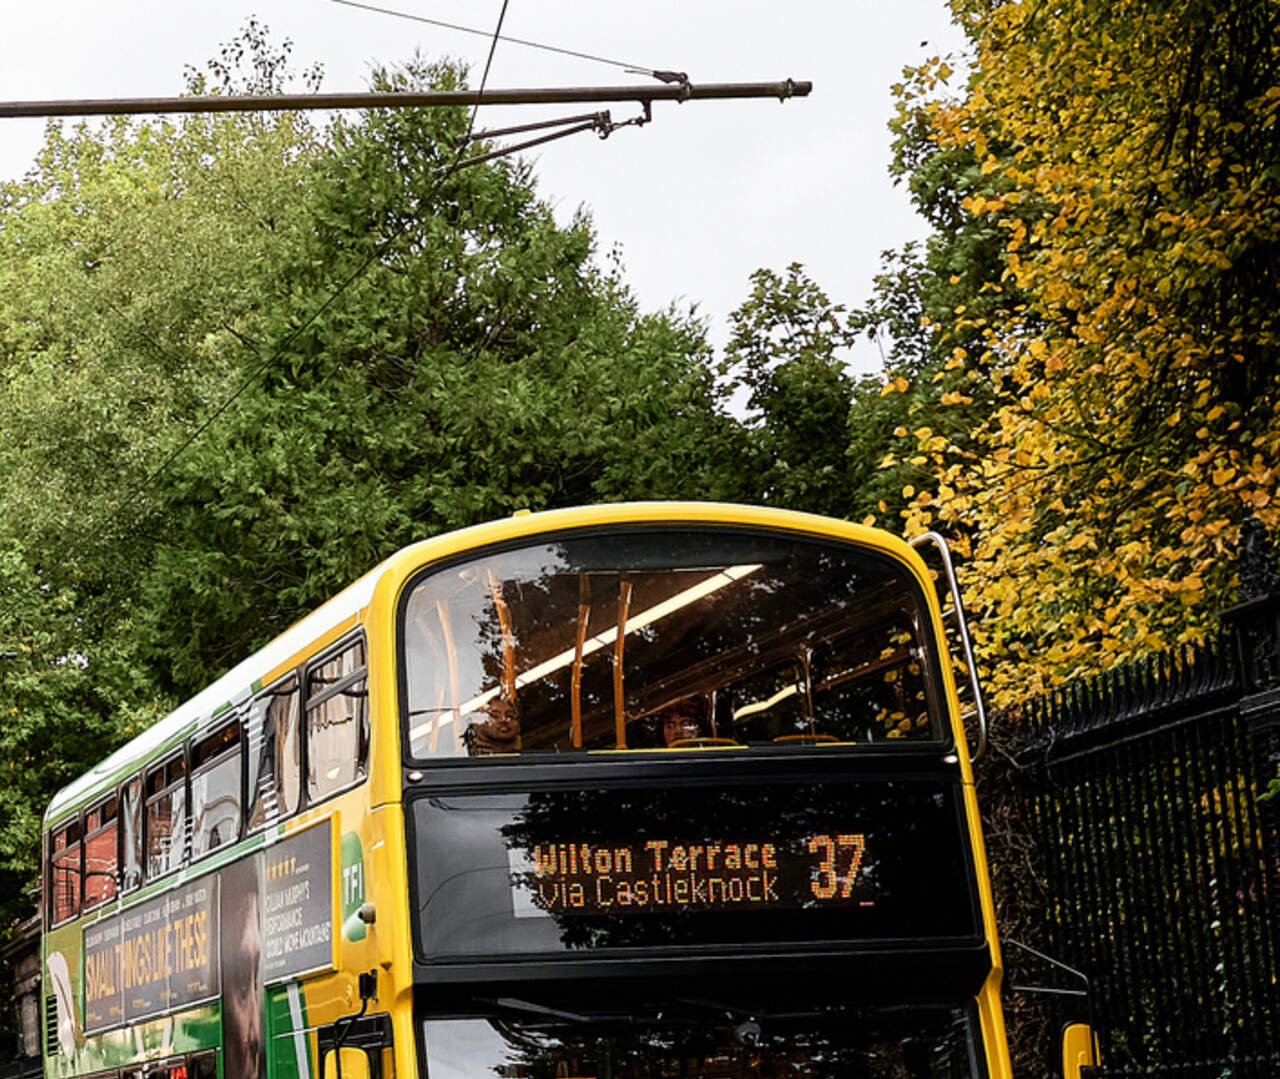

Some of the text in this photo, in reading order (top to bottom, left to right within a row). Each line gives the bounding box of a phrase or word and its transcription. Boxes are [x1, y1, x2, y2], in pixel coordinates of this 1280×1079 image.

[535, 840, 777, 874] Wilton Terrace
[808, 835, 866, 898] 37
[343, 862, 362, 905] TFI
[539, 870, 779, 908] via Castleknock
[86, 947, 115, 1002] SMALL
[115, 932, 151, 993] THINGS
[174, 910, 208, 973] THESE
